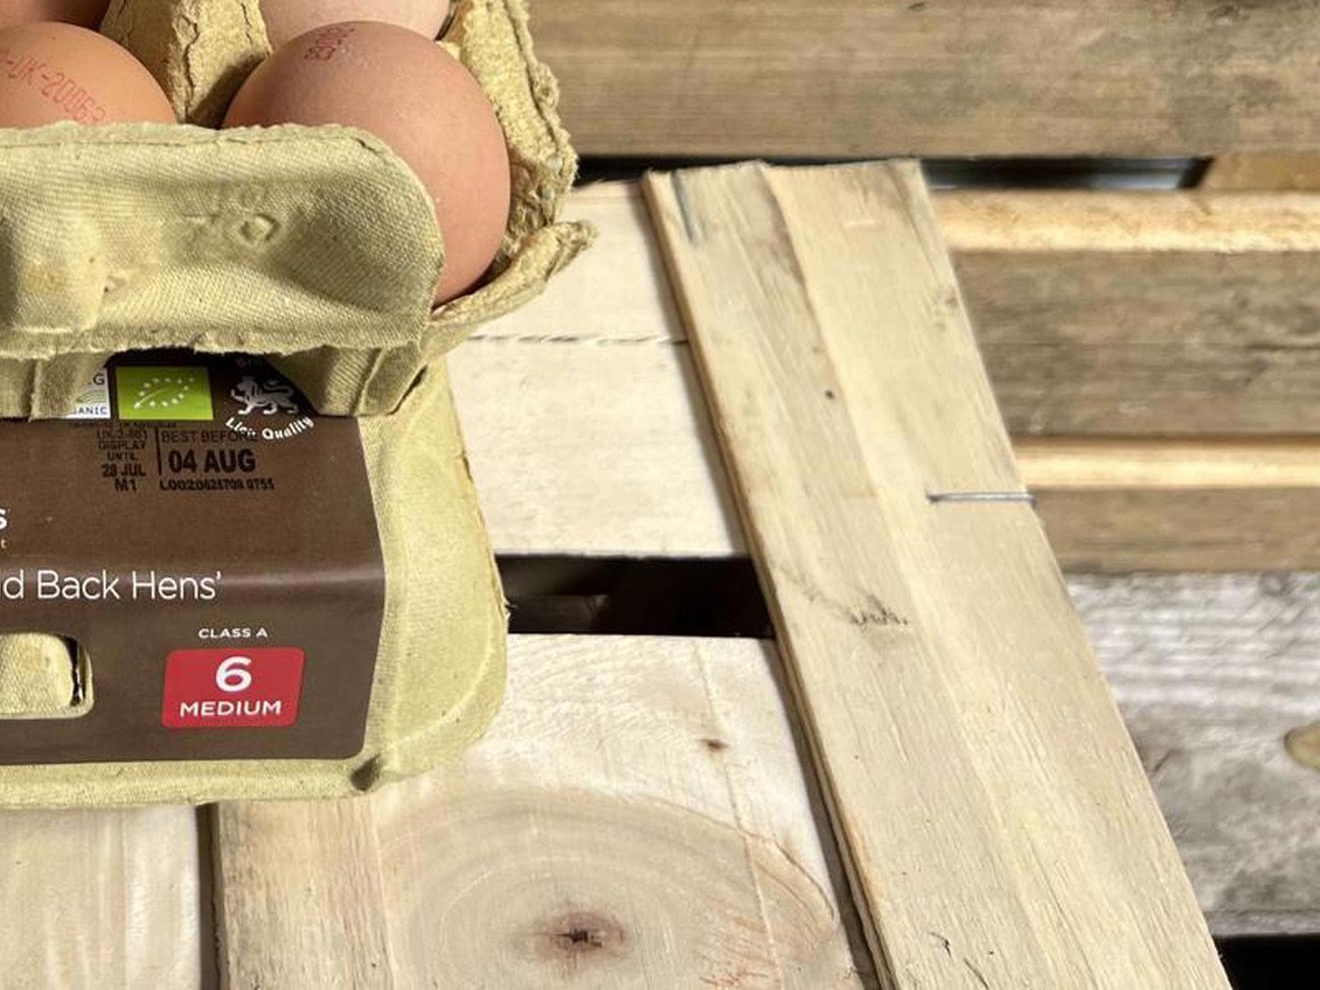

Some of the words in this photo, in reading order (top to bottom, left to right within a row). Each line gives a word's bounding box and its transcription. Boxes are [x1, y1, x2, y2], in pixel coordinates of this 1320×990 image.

[161, 430, 199, 443] BEST
[261, 416, 315, 440] Quality
[121, 463, 147, 477] JUL
[168, 448, 198, 473] 04
[204, 448, 256, 473] AUG
[37, 569, 120, 600] Back
[198, 628, 252, 639] CLASS
[255, 628, 268, 639] A
[216, 656, 253, 693] 6
[179, 701, 282, 718] MEDIUM
